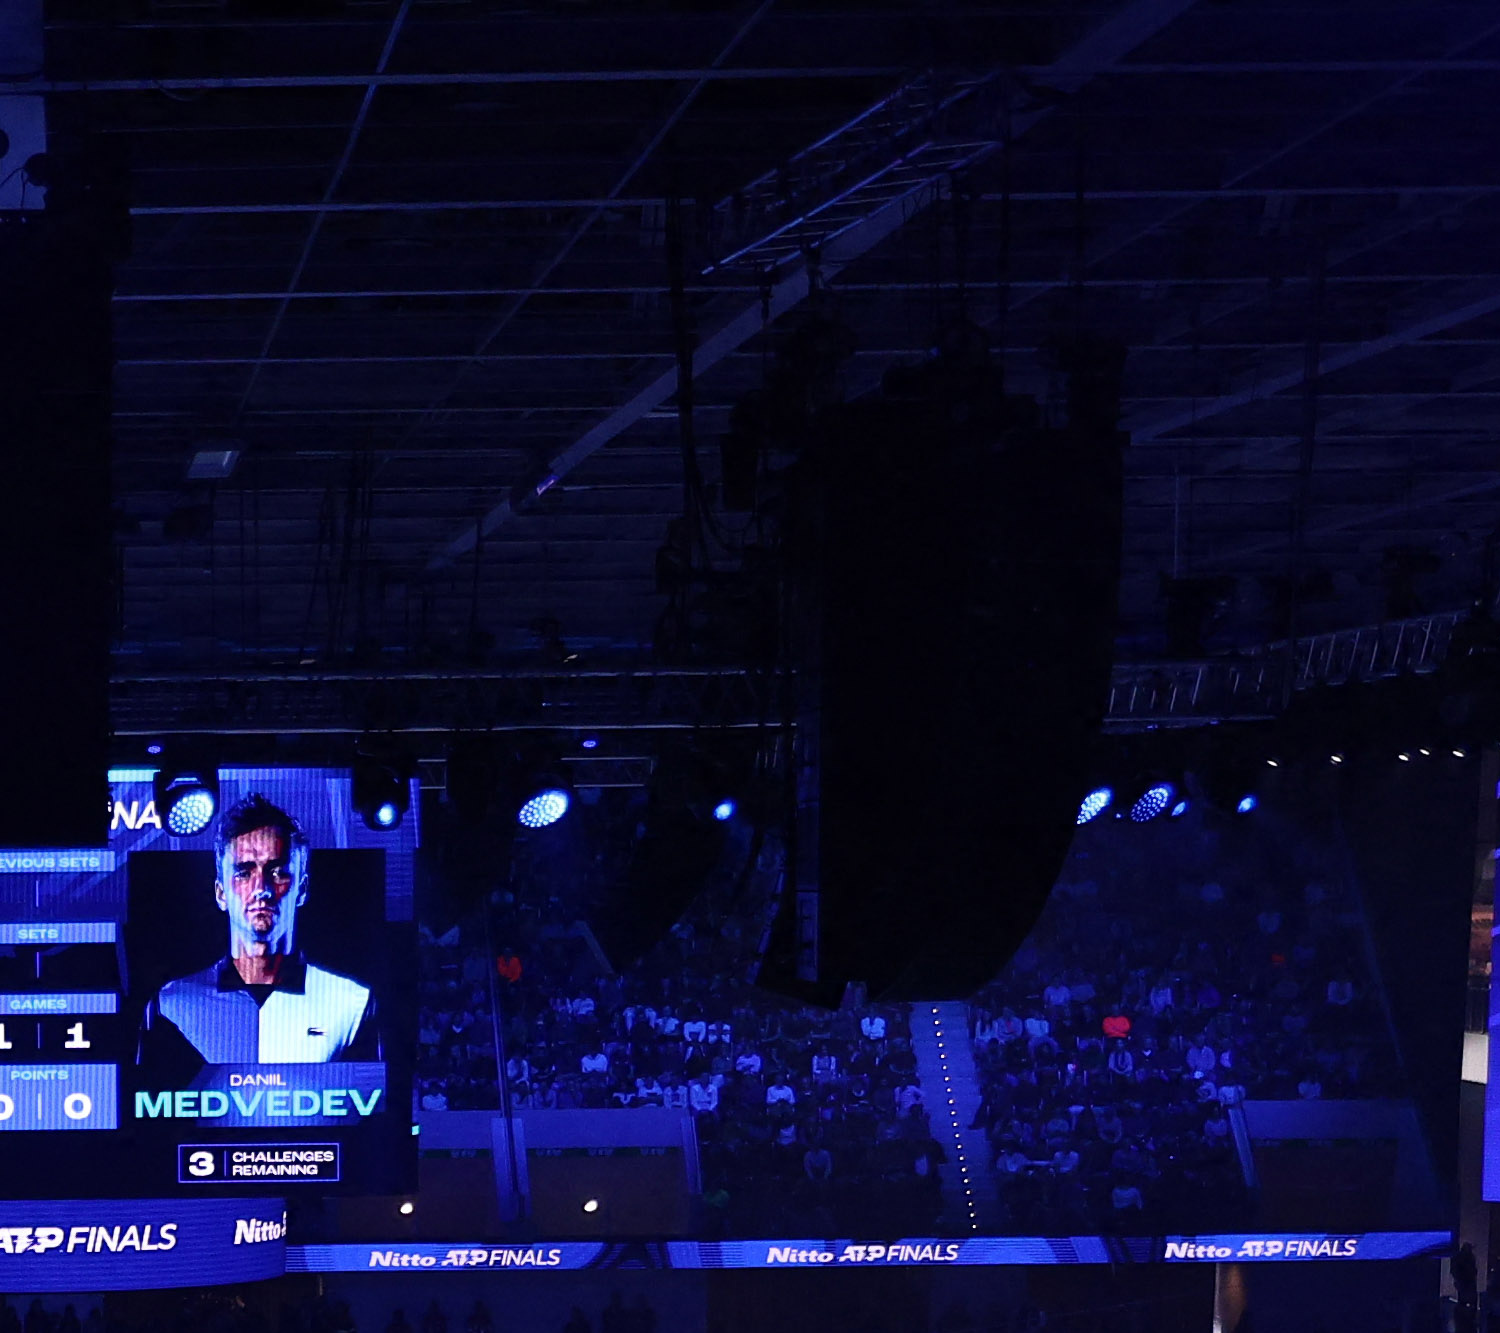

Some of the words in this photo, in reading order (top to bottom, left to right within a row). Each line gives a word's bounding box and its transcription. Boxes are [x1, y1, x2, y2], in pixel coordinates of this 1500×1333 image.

[59, 856, 101, 869] SETS
[17, 928, 60, 941] SETS
[9, 997, 68, 1010] GAMES
[64, 1022, 90, 1049] 1
[10, 1068, 69, 1082] POINTS
[229, 1073, 287, 1087] DANIIL
[63, 1091, 92, 1120] 0
[135, 1089, 382, 1119] MEDVEDEV
[188, 1151, 215, 1177] 3
[232, 1150, 335, 1163] CHALLENGES
[232, 1163, 319, 1176] REMAINING
[67, 1222, 178, 1252] FINALS
[233, 1219, 281, 1246] Nitto
[368, 1251, 436, 1268] Nitto
[440, 1249, 488, 1267] ATP
[488, 1248, 562, 1267] FINALS
[766, 1247, 834, 1264] Nitto
[838, 1245, 886, 1262] ATP
[886, 1243, 960, 1262] FINALS
[1165, 1241, 1232, 1259] Nitto
[1235, 1240, 1284, 1258] ATP
[1283, 1238, 1357, 1257] FINALS
